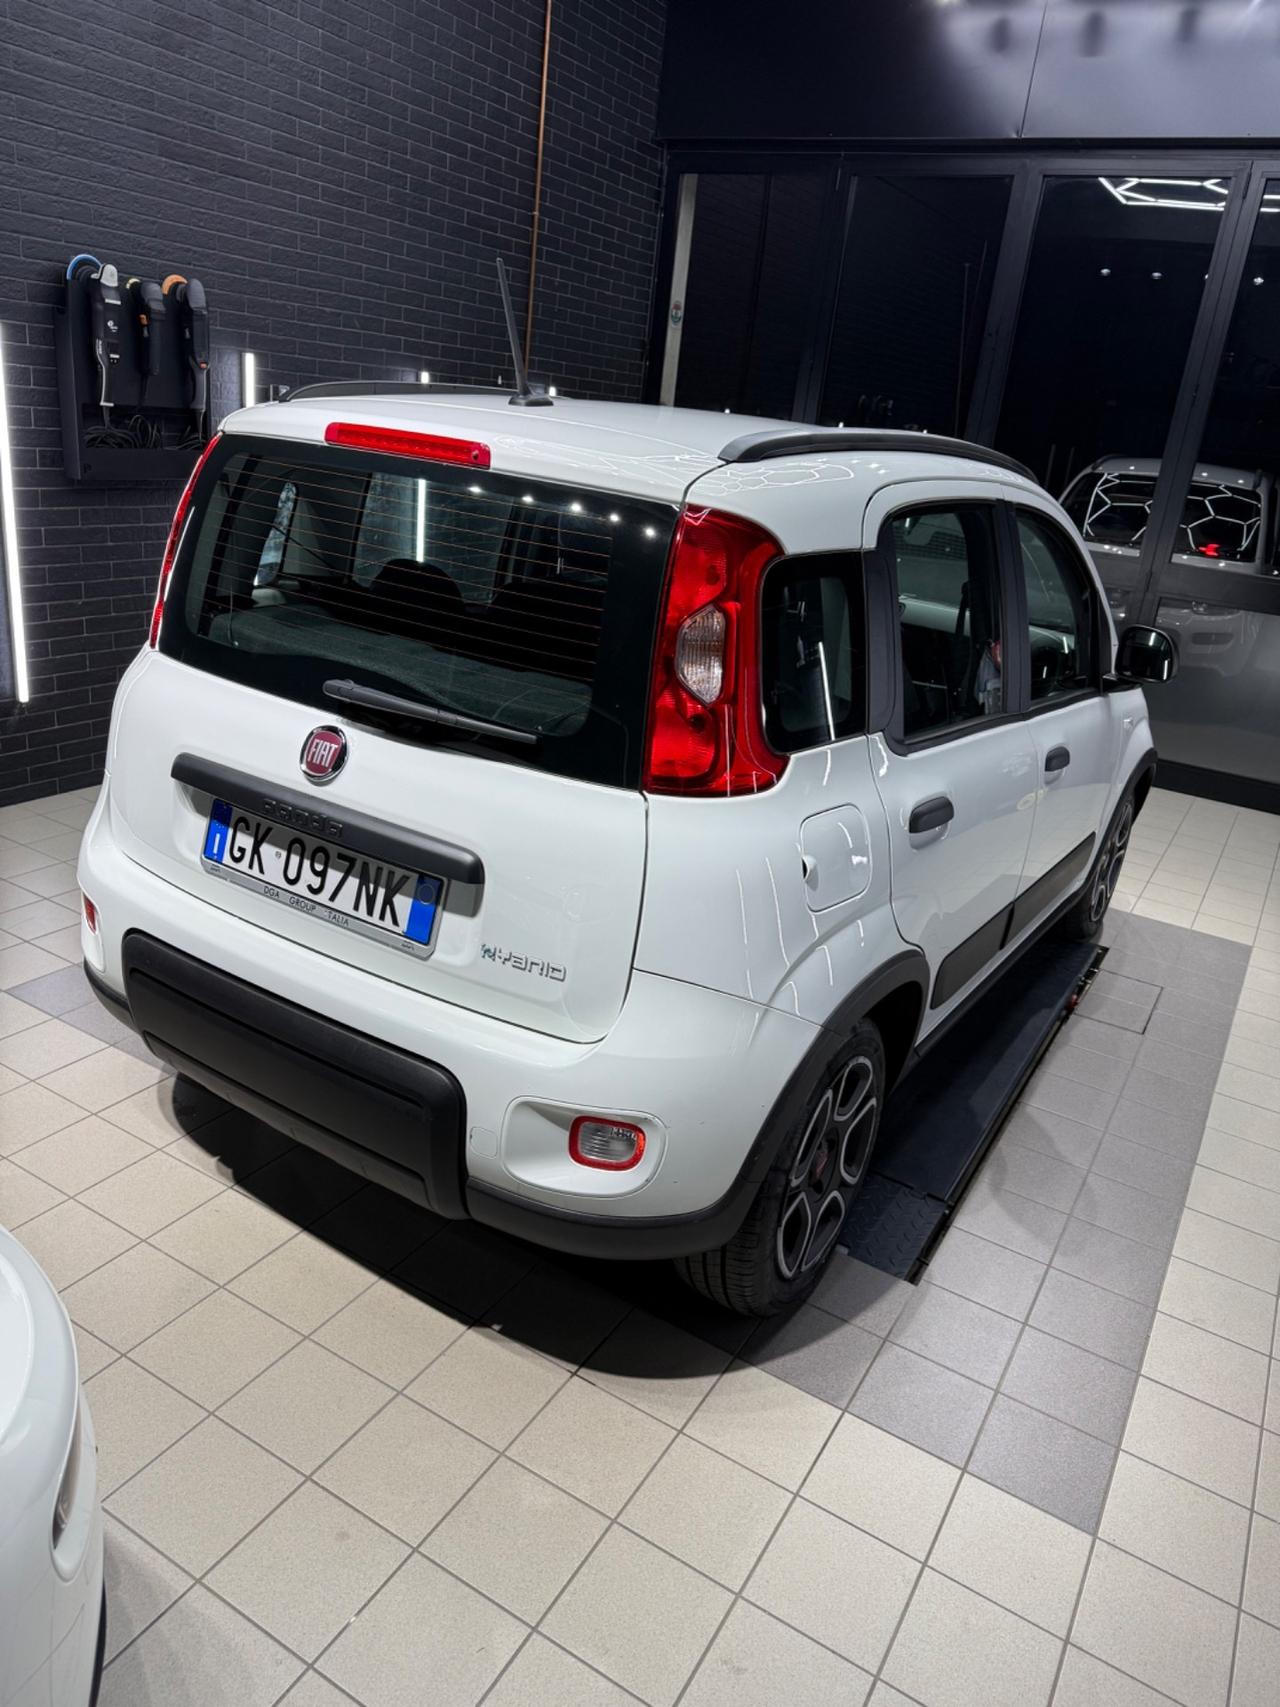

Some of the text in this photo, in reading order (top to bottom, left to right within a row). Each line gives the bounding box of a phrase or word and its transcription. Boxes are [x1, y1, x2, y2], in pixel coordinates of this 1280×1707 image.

[307, 738, 339, 768] FIAT
[229, 816, 410, 928] GK 097NK
[263, 885, 280, 899] DGA
[289, 896, 317, 913] GROUP
